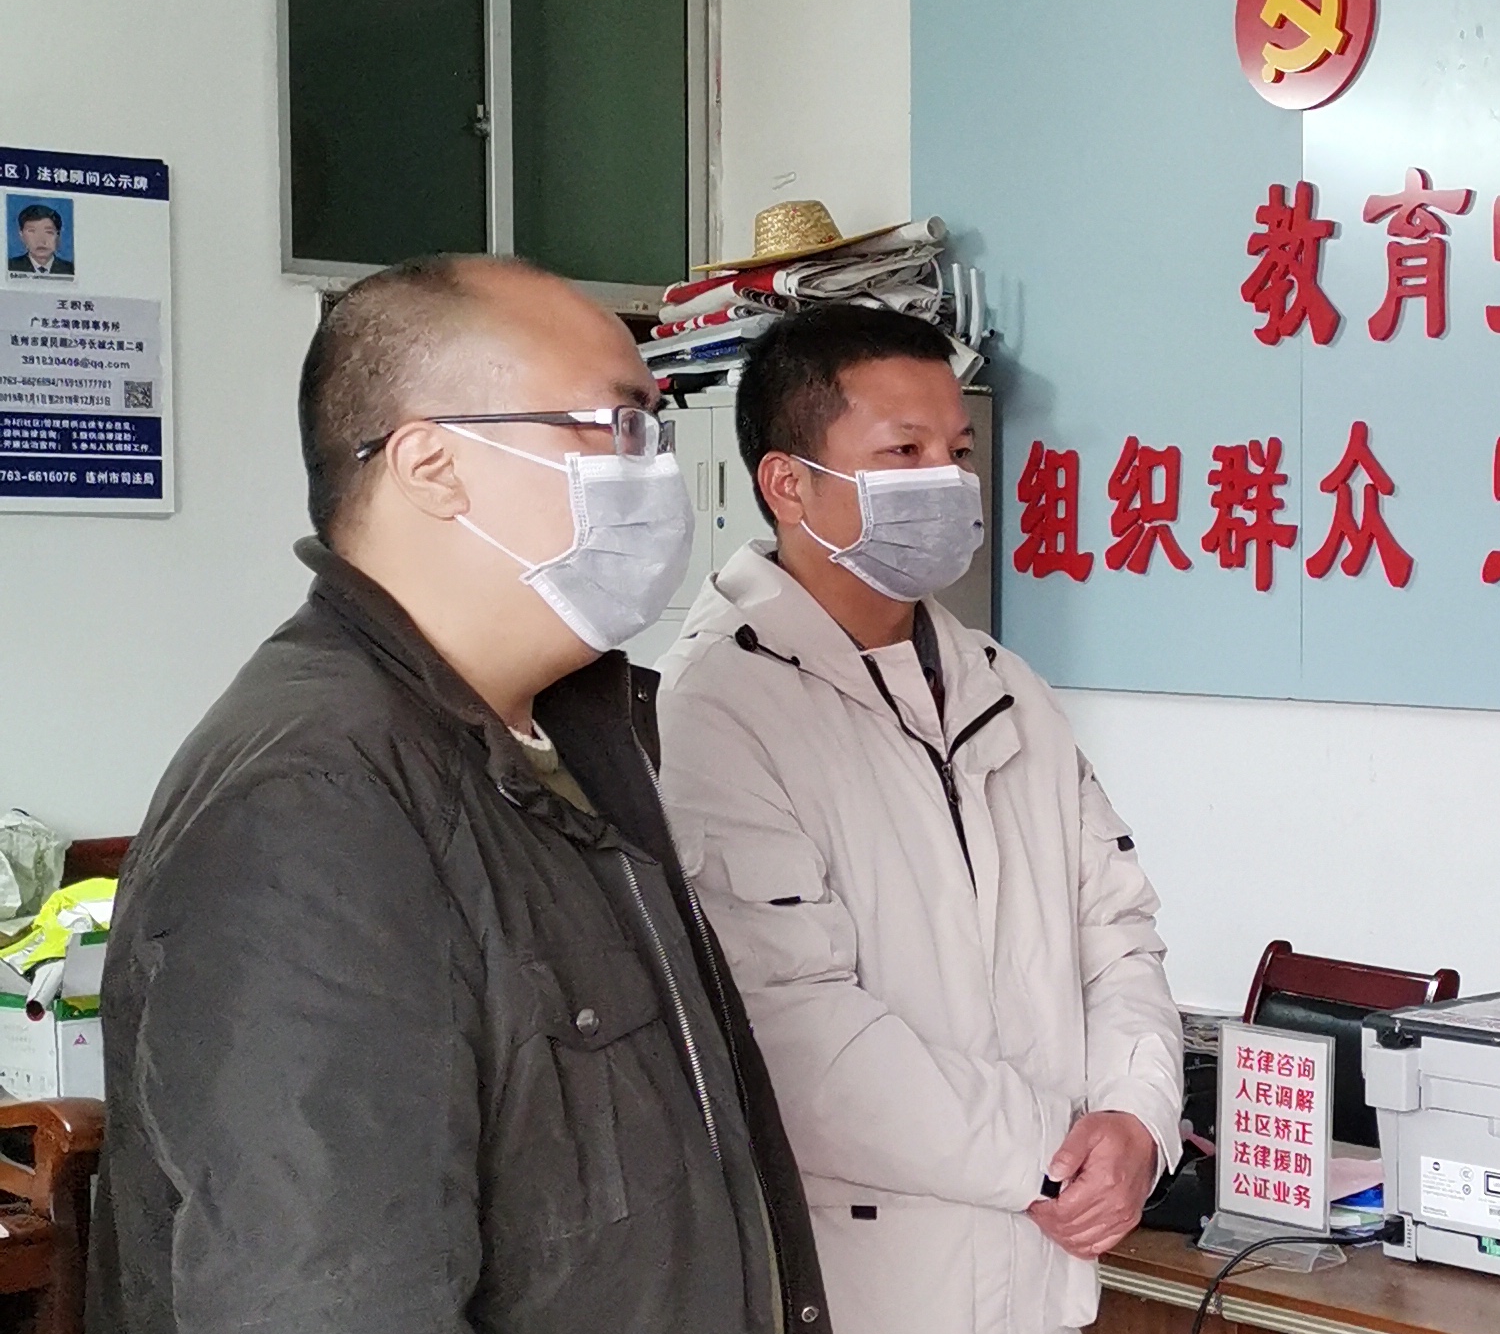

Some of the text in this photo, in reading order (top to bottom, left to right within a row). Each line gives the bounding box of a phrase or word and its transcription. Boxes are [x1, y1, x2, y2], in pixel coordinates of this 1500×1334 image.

[0, 163, 149, 191] 区）法律顾问公示牌
[1011, 421, 1414, 592] 组织群众
[1236, 1046, 1316, 1081] 法律咨询
[1235, 1078, 1315, 1113] 人民调解
[1234, 1109, 1313, 1145] 社区矫正
[1233, 1140, 1312, 1177] 法律援助
[1233, 1172, 1312, 1209] 公证业务
